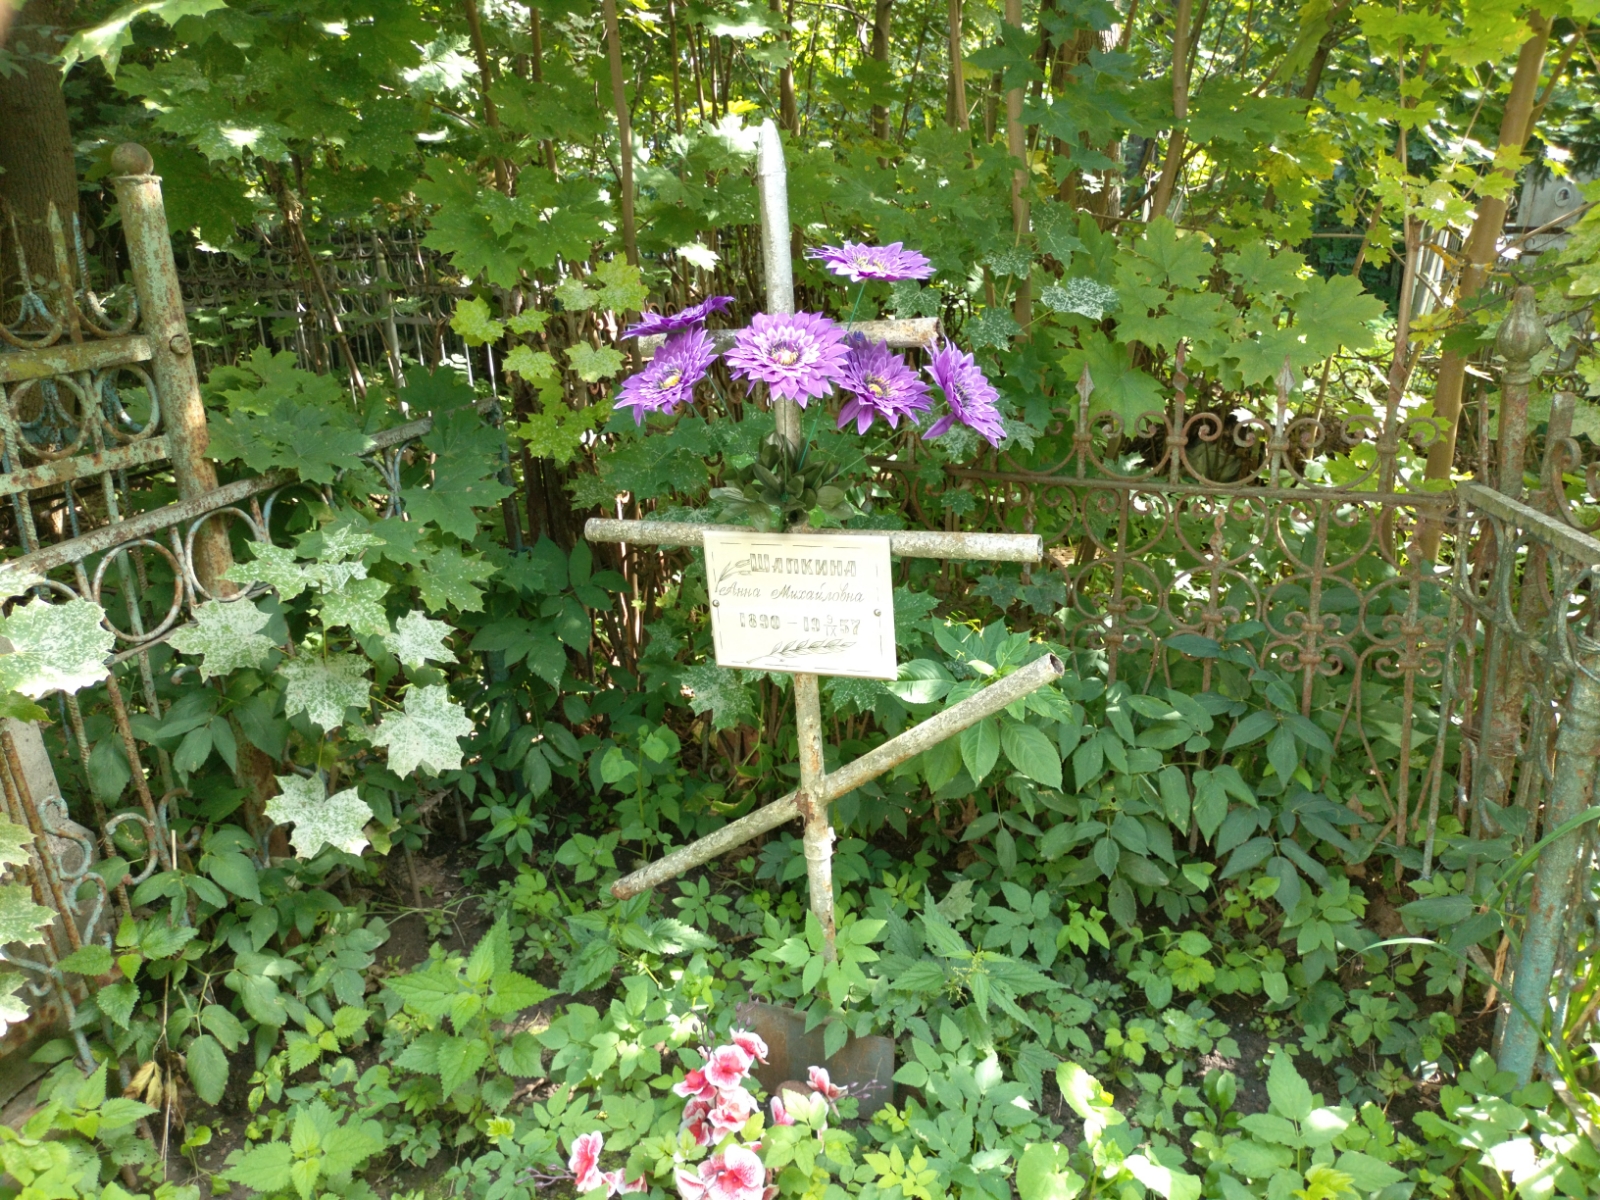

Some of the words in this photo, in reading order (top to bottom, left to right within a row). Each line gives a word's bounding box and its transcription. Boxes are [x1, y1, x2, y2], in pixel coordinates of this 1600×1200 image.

[750, 553, 857, 577] ШАПКИНА
[718, 581, 762, 598] Анна
[770, 582, 865, 602] Михайловна
